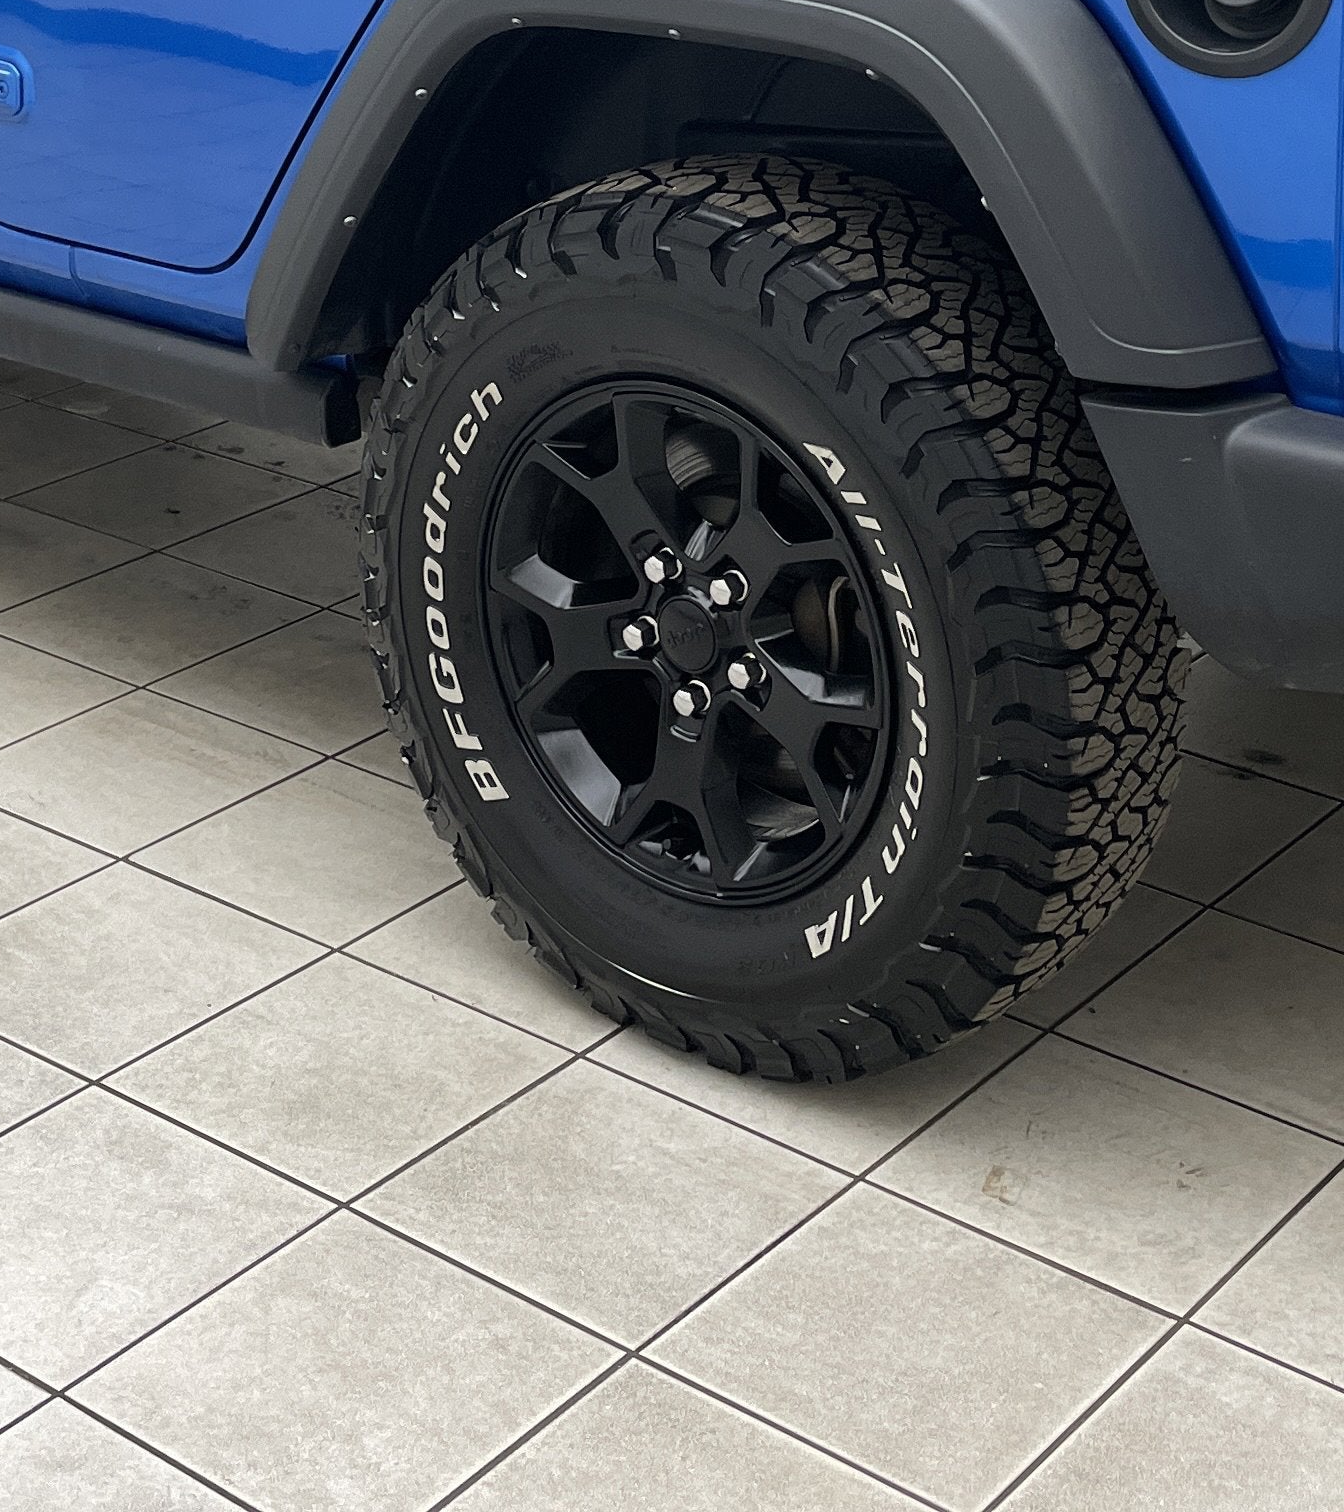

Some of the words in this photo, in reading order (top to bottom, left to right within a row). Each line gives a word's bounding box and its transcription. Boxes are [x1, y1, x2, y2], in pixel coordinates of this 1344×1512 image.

[422, 381, 510, 801] BFGoodrich
[803, 441, 928, 874] All-Terrain
[804, 875, 884, 959] T/A
